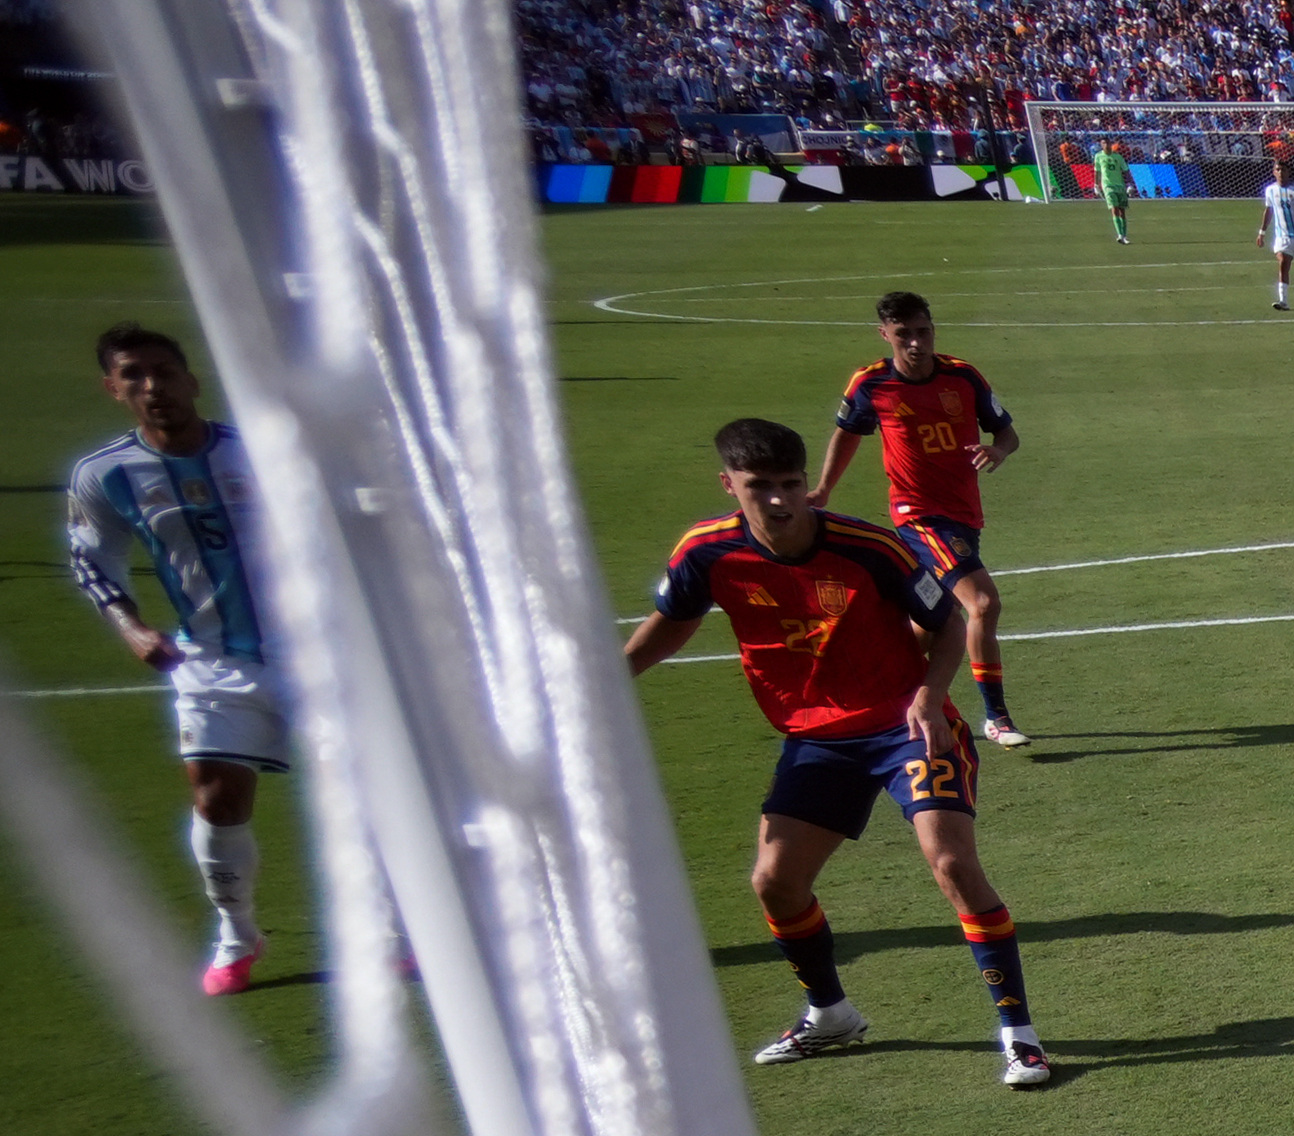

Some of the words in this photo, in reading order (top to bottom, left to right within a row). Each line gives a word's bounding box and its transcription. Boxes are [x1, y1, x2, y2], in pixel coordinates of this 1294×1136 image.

[917, 421, 958, 454] 20
[780, 618, 830, 658] 22
[904, 758, 959, 801] 22
